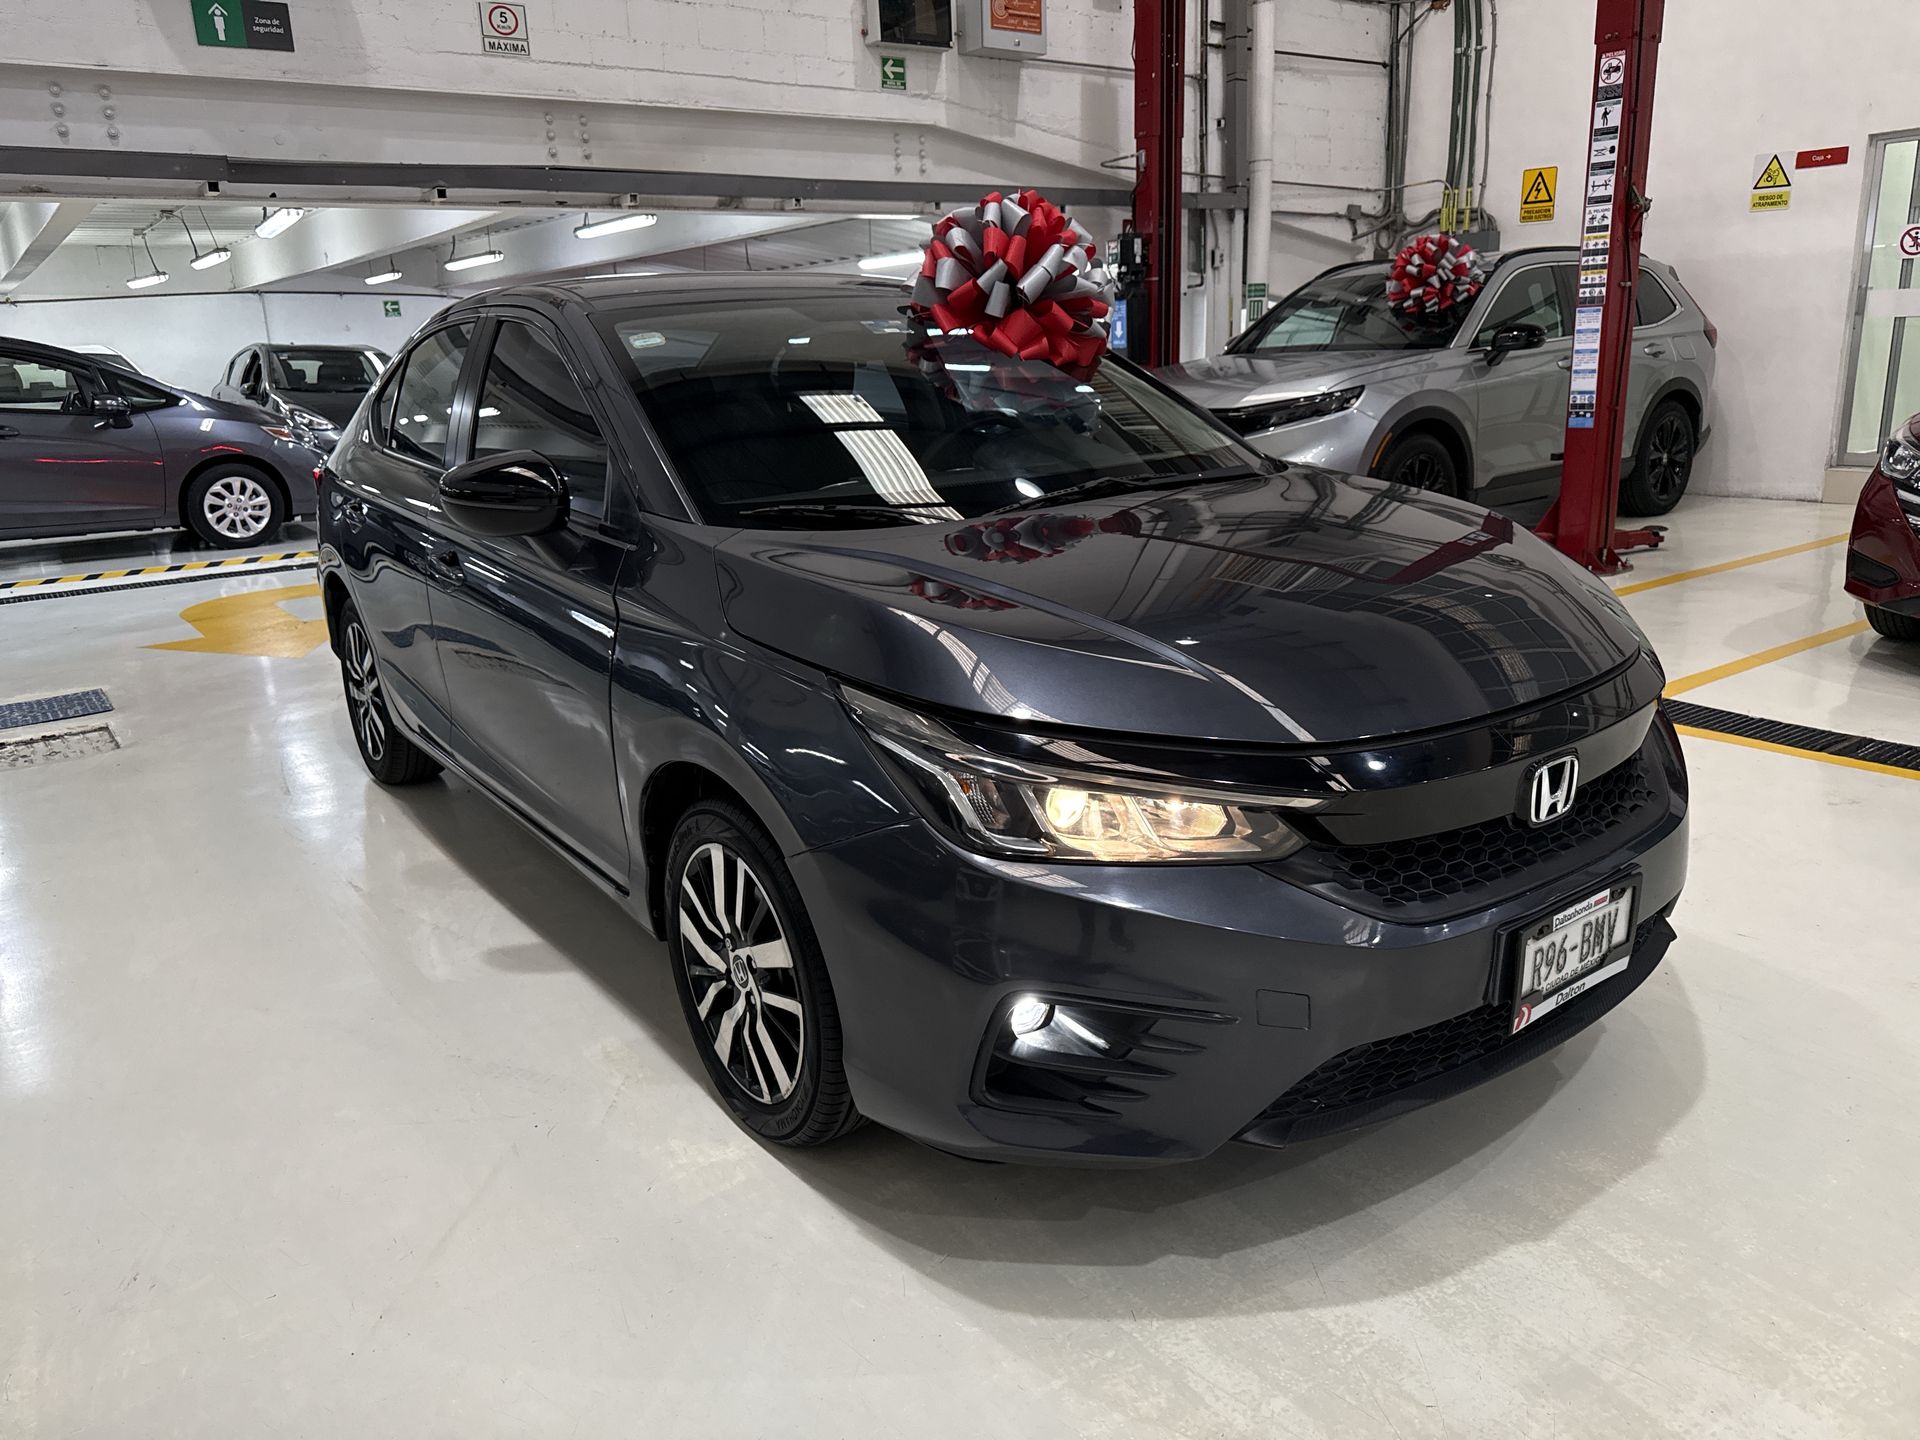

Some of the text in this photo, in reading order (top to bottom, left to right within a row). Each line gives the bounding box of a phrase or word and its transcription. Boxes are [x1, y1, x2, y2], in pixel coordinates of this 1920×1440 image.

[254, 16, 271, 24] Zona
[499, 11, 508, 24] 5
[252, 26, 284, 34] seguridad
[1554, 901, 1593, 928] Daltonhonda
[1545, 971, 1568, 992] CIUDAD
[1568, 966, 1579, 977] DE
[1555, 982, 1586, 1006] Dalton
